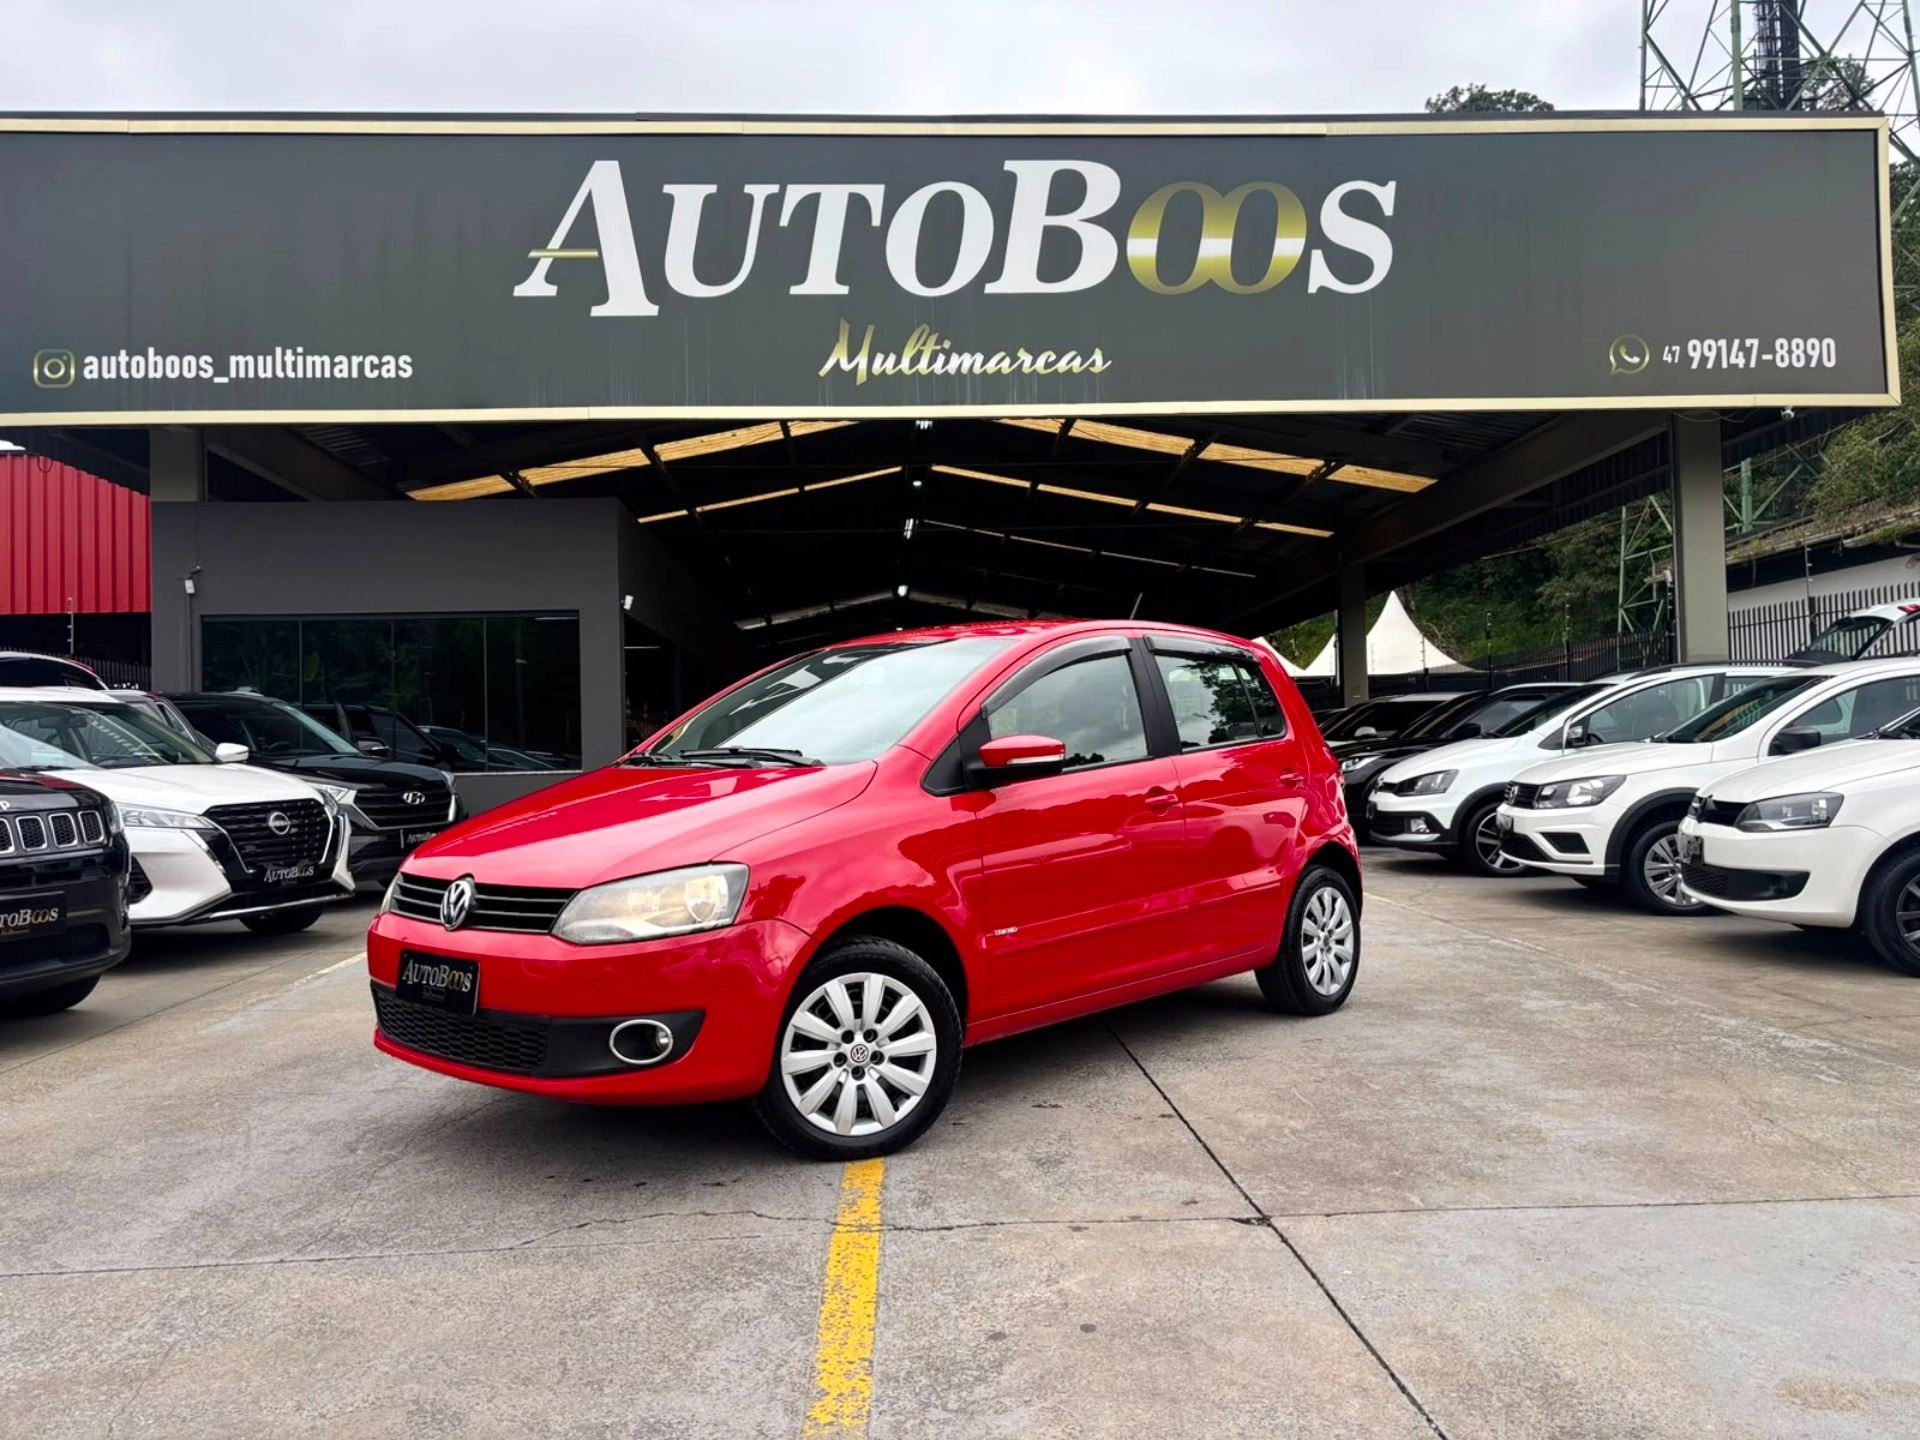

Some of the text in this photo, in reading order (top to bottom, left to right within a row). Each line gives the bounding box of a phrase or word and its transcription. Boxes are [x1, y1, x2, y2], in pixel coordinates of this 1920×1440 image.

[83, 347, 413, 384] autoboos_multimarcas
[818, 317, 1112, 385] Multimarcas
[1662, 337, 1837, 370] 47 99147-8890
